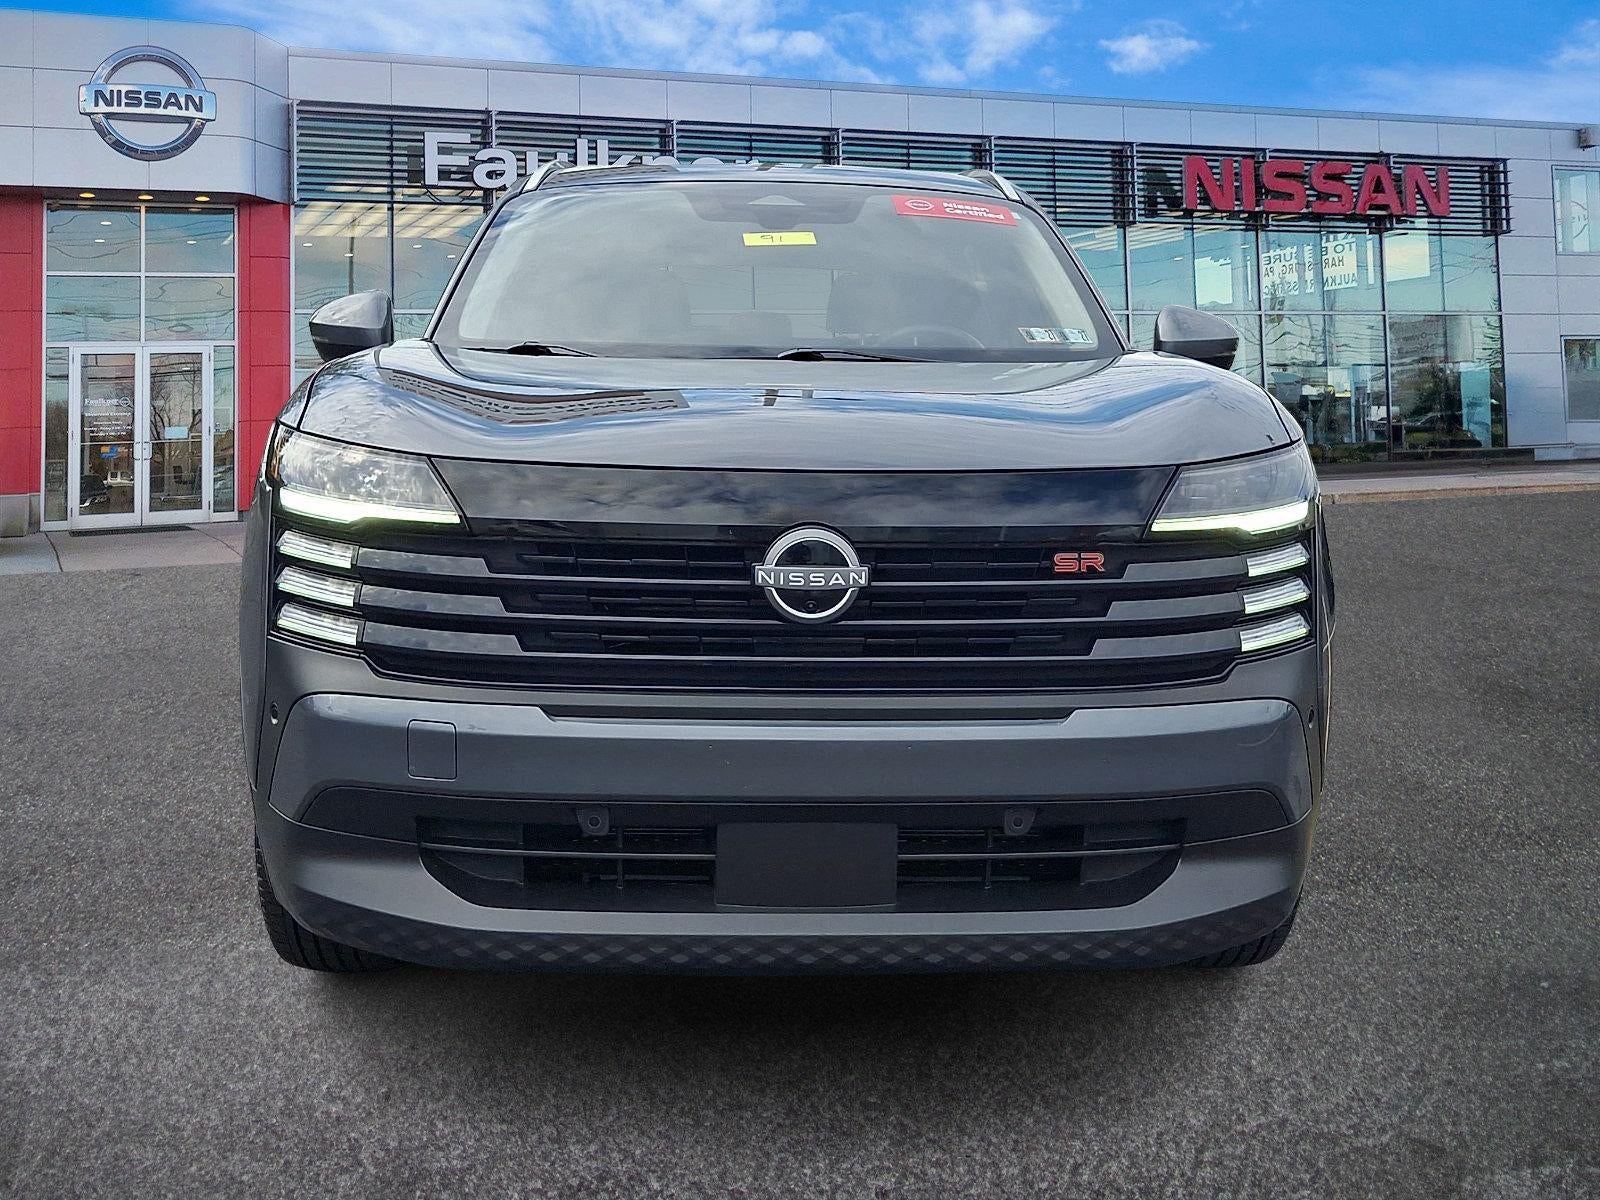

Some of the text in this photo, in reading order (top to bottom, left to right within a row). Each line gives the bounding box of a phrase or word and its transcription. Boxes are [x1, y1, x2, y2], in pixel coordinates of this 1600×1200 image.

[93, 89, 203, 112] NISSAN
[1182, 156, 1450, 216] NISSAN
[1053, 552, 1105, 573] SR
[757, 569, 867, 586] NISSAN
